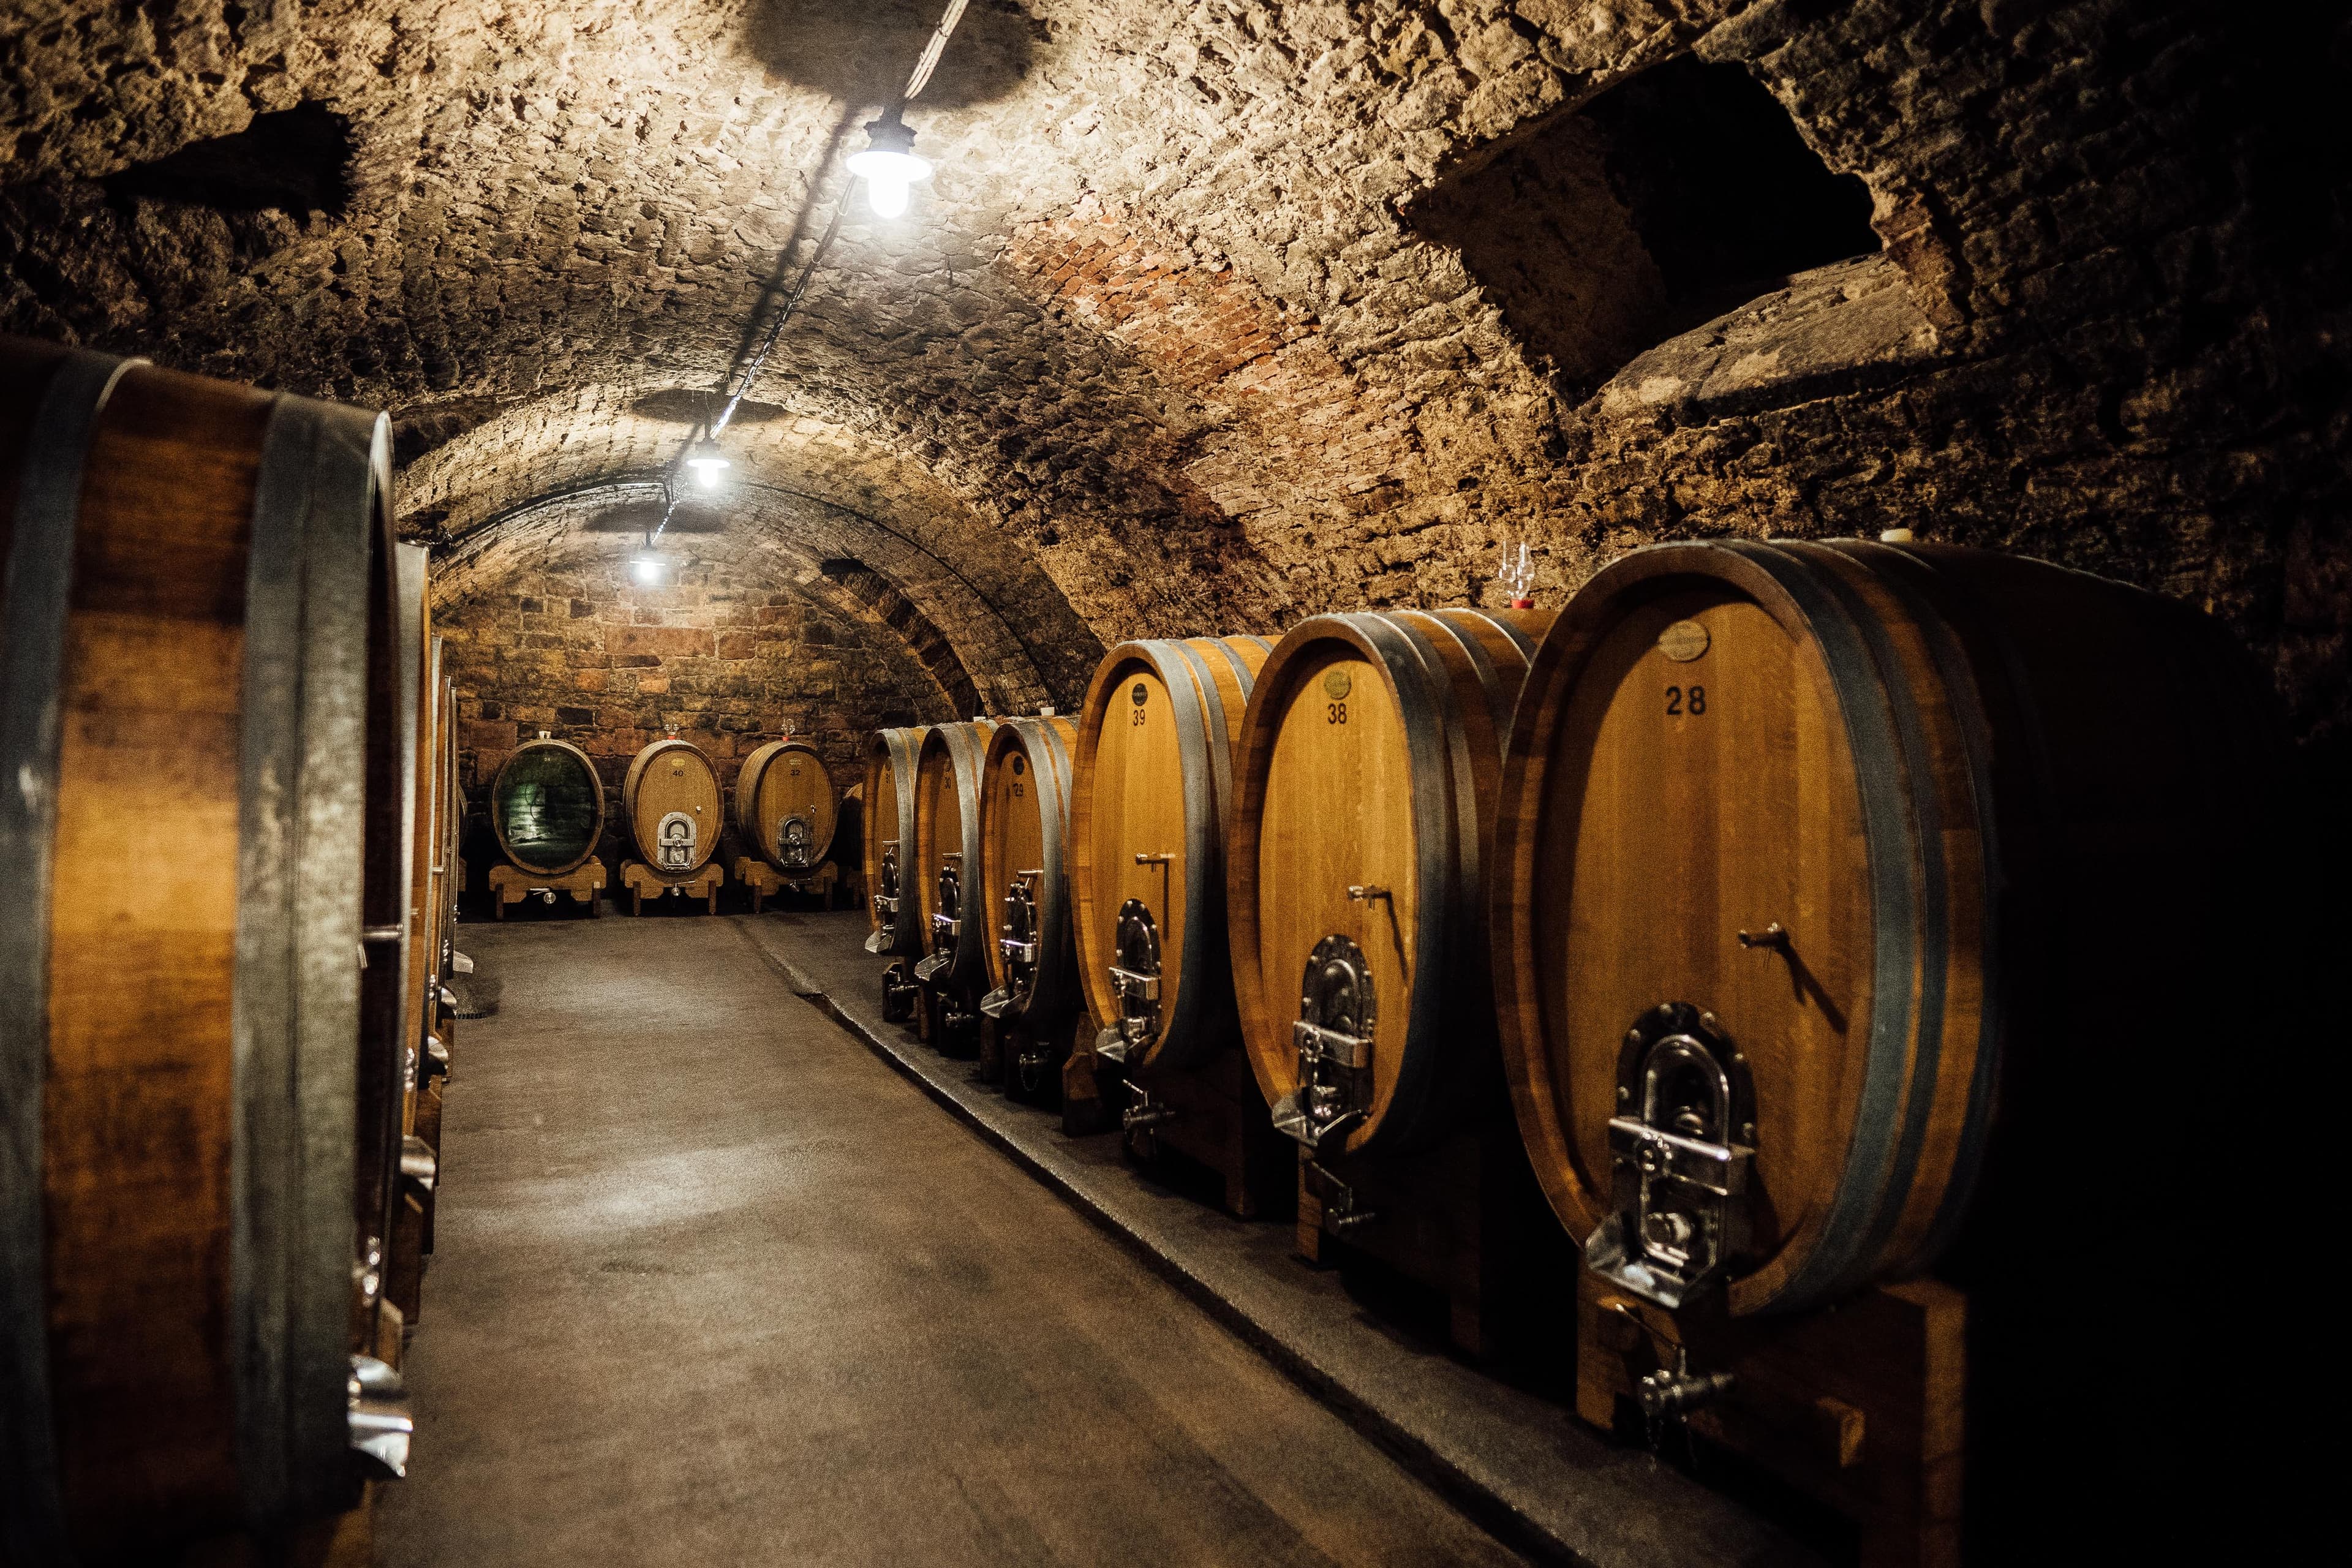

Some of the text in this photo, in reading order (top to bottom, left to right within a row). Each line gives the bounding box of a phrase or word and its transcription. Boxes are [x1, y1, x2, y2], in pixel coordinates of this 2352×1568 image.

[1666, 686, 1706, 716] 28
[1133, 709, 1145, 726] 39
[1328, 703, 1347, 724] 38
[1013, 783, 1023, 797] 29
